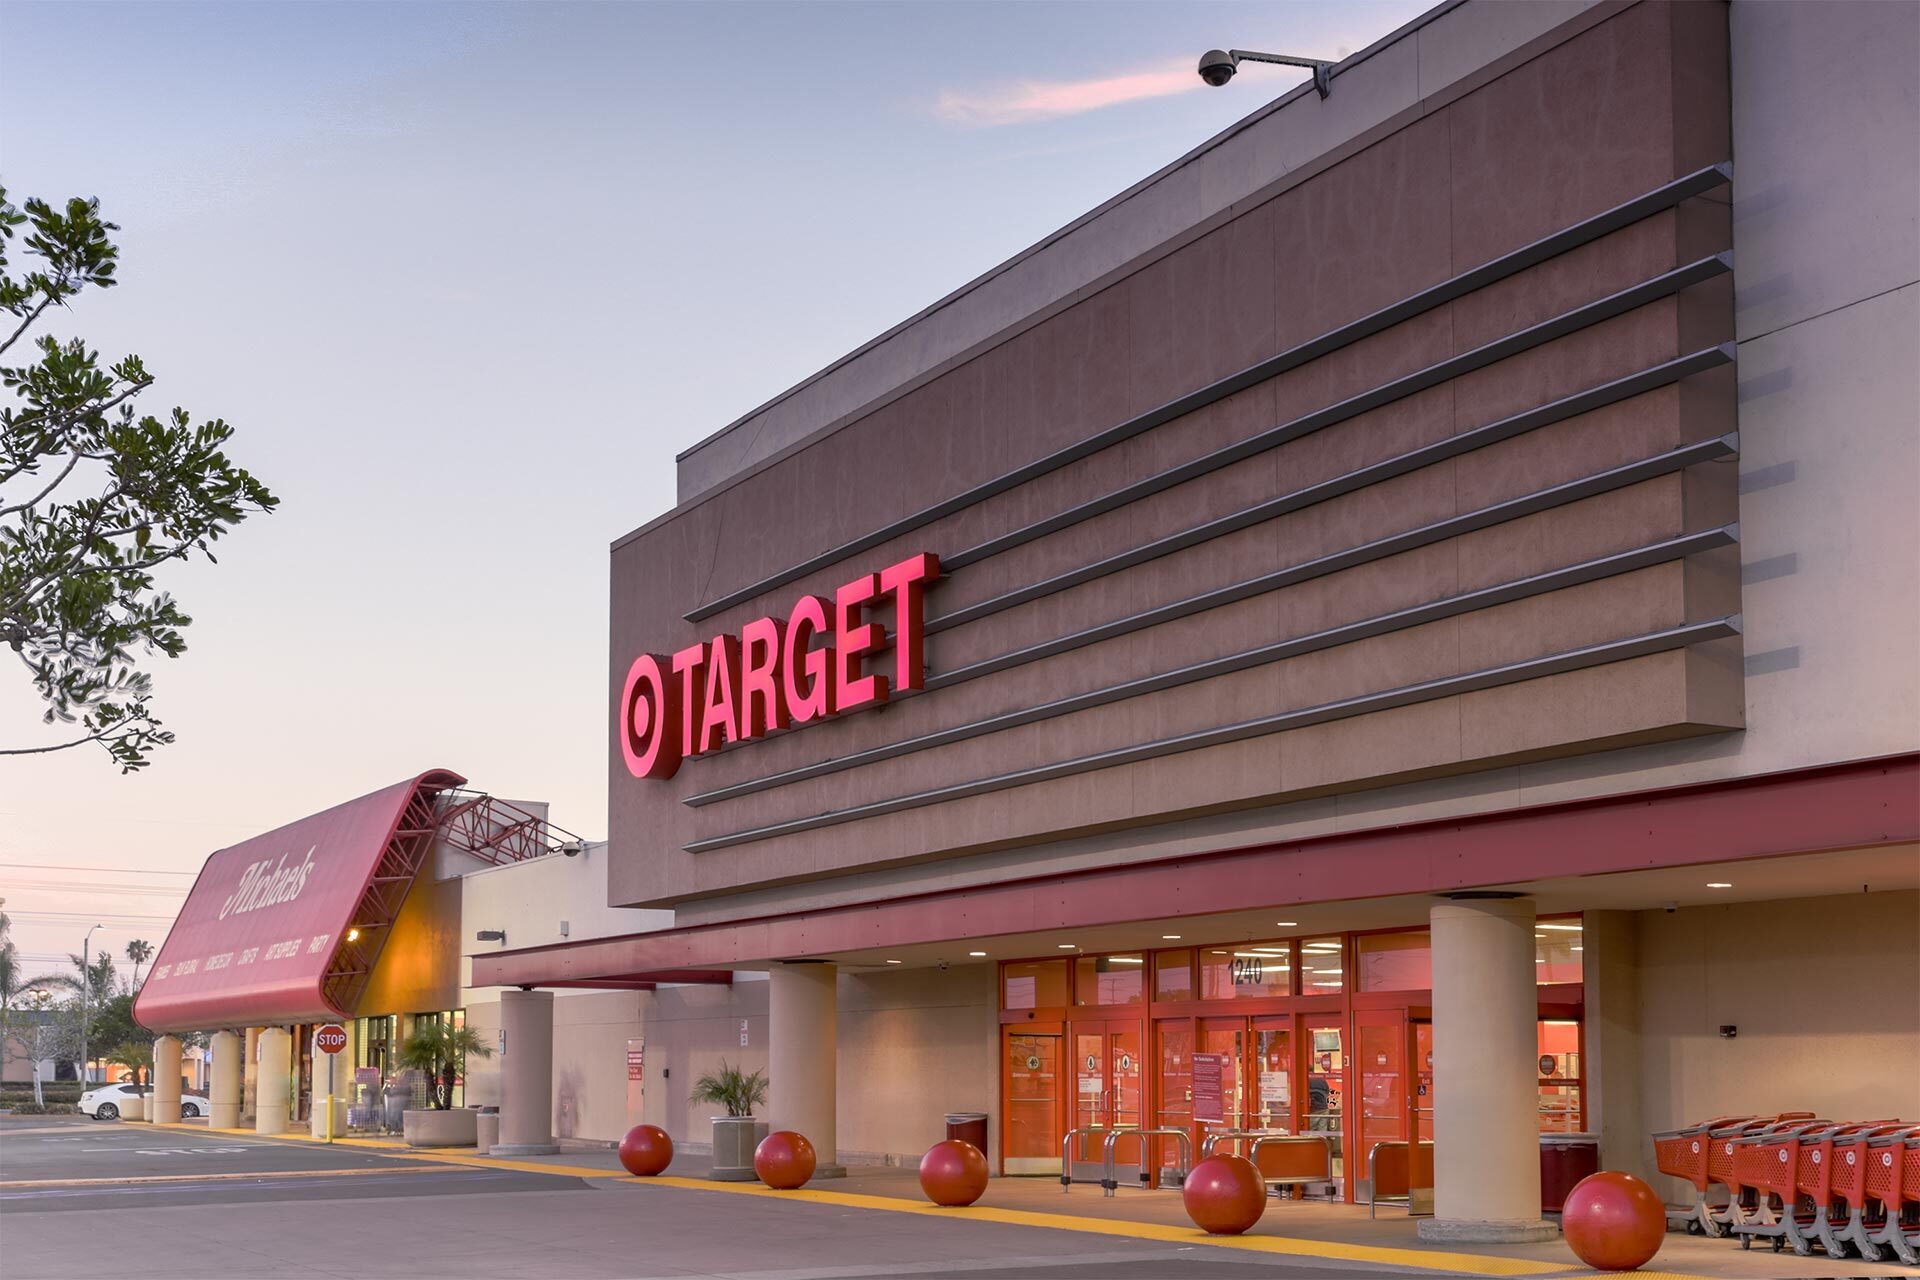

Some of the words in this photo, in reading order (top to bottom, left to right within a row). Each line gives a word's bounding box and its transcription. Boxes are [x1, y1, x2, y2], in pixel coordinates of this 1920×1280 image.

[672, 553, 932, 757] TARGET
[219, 844, 317, 920] Michaels
[1228, 957, 1262, 985] 1240
[318, 1034, 345, 1046] STOP
